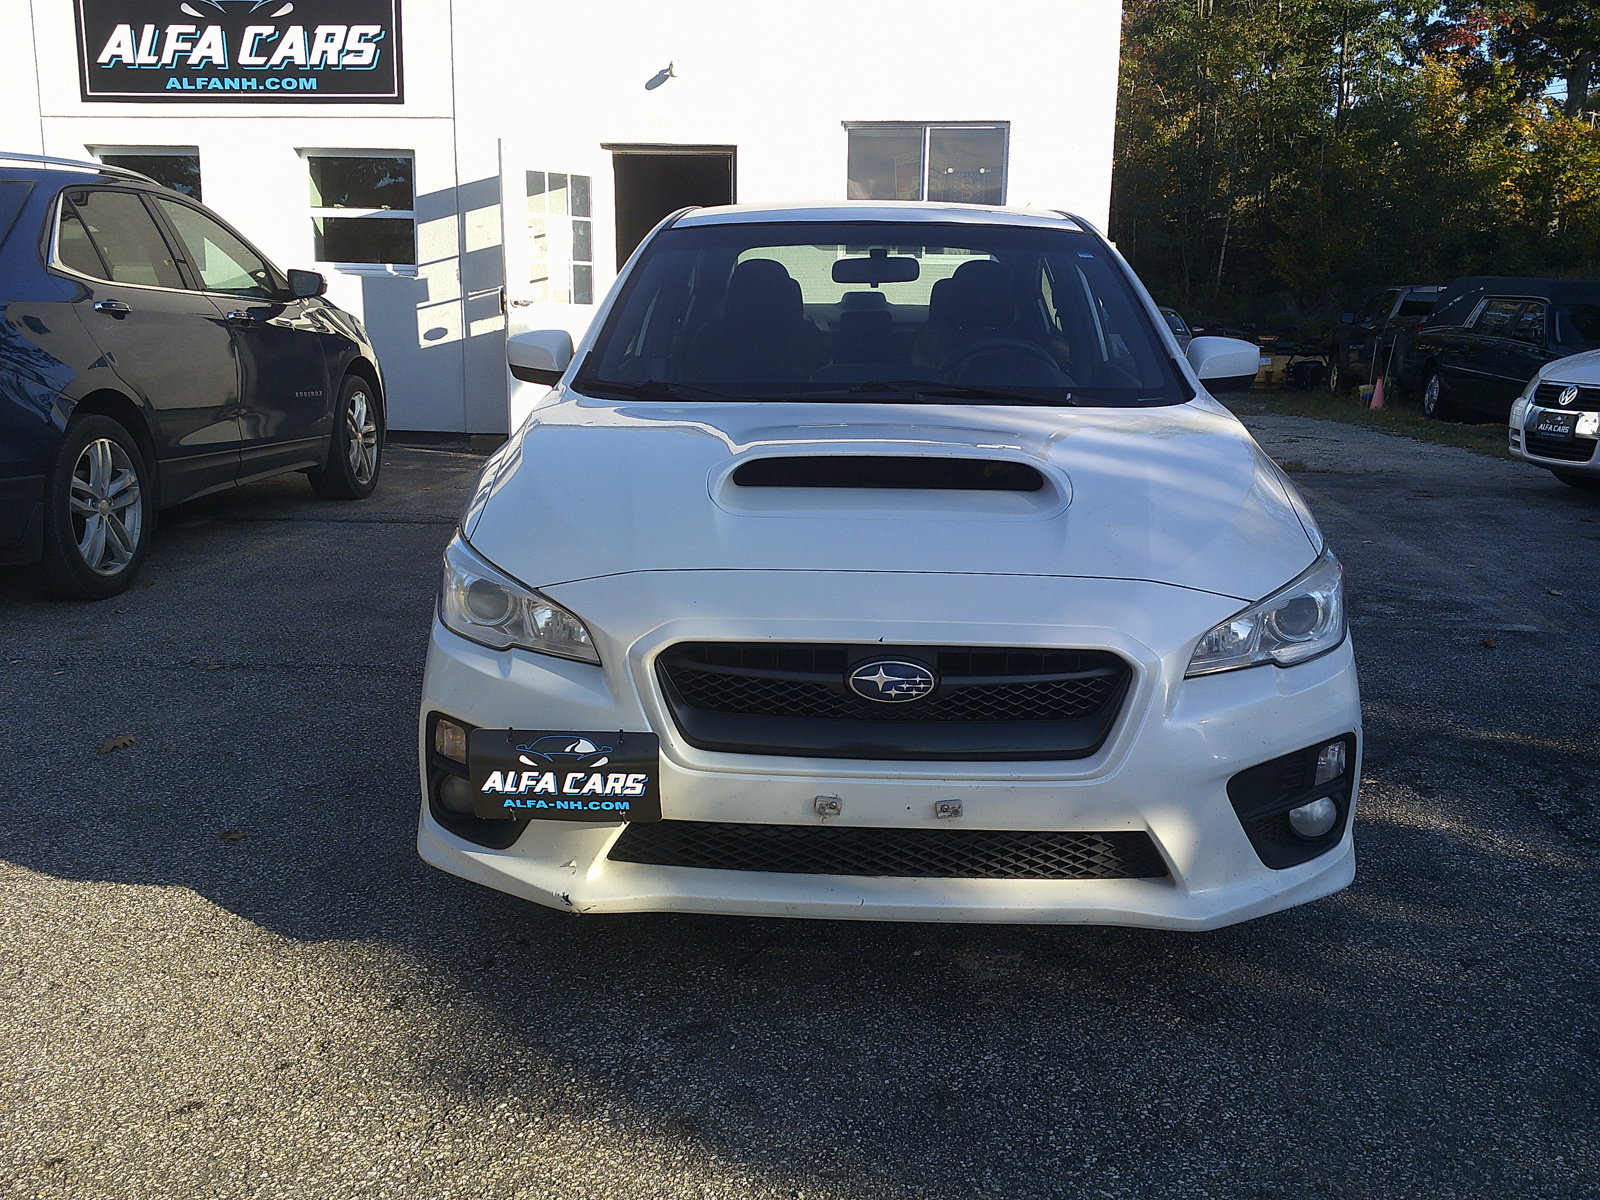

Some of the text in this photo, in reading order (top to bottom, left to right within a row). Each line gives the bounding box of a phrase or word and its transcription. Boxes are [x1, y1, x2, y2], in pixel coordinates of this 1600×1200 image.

[97, 24, 385, 70] ALFA CARS
[165, 77, 318, 91] ALFANH.COM
[1538, 423, 1570, 433] ALFA CARS
[481, 771, 649, 796] ALFA CARS
[503, 799, 630, 811] ALFA-NH.COM
